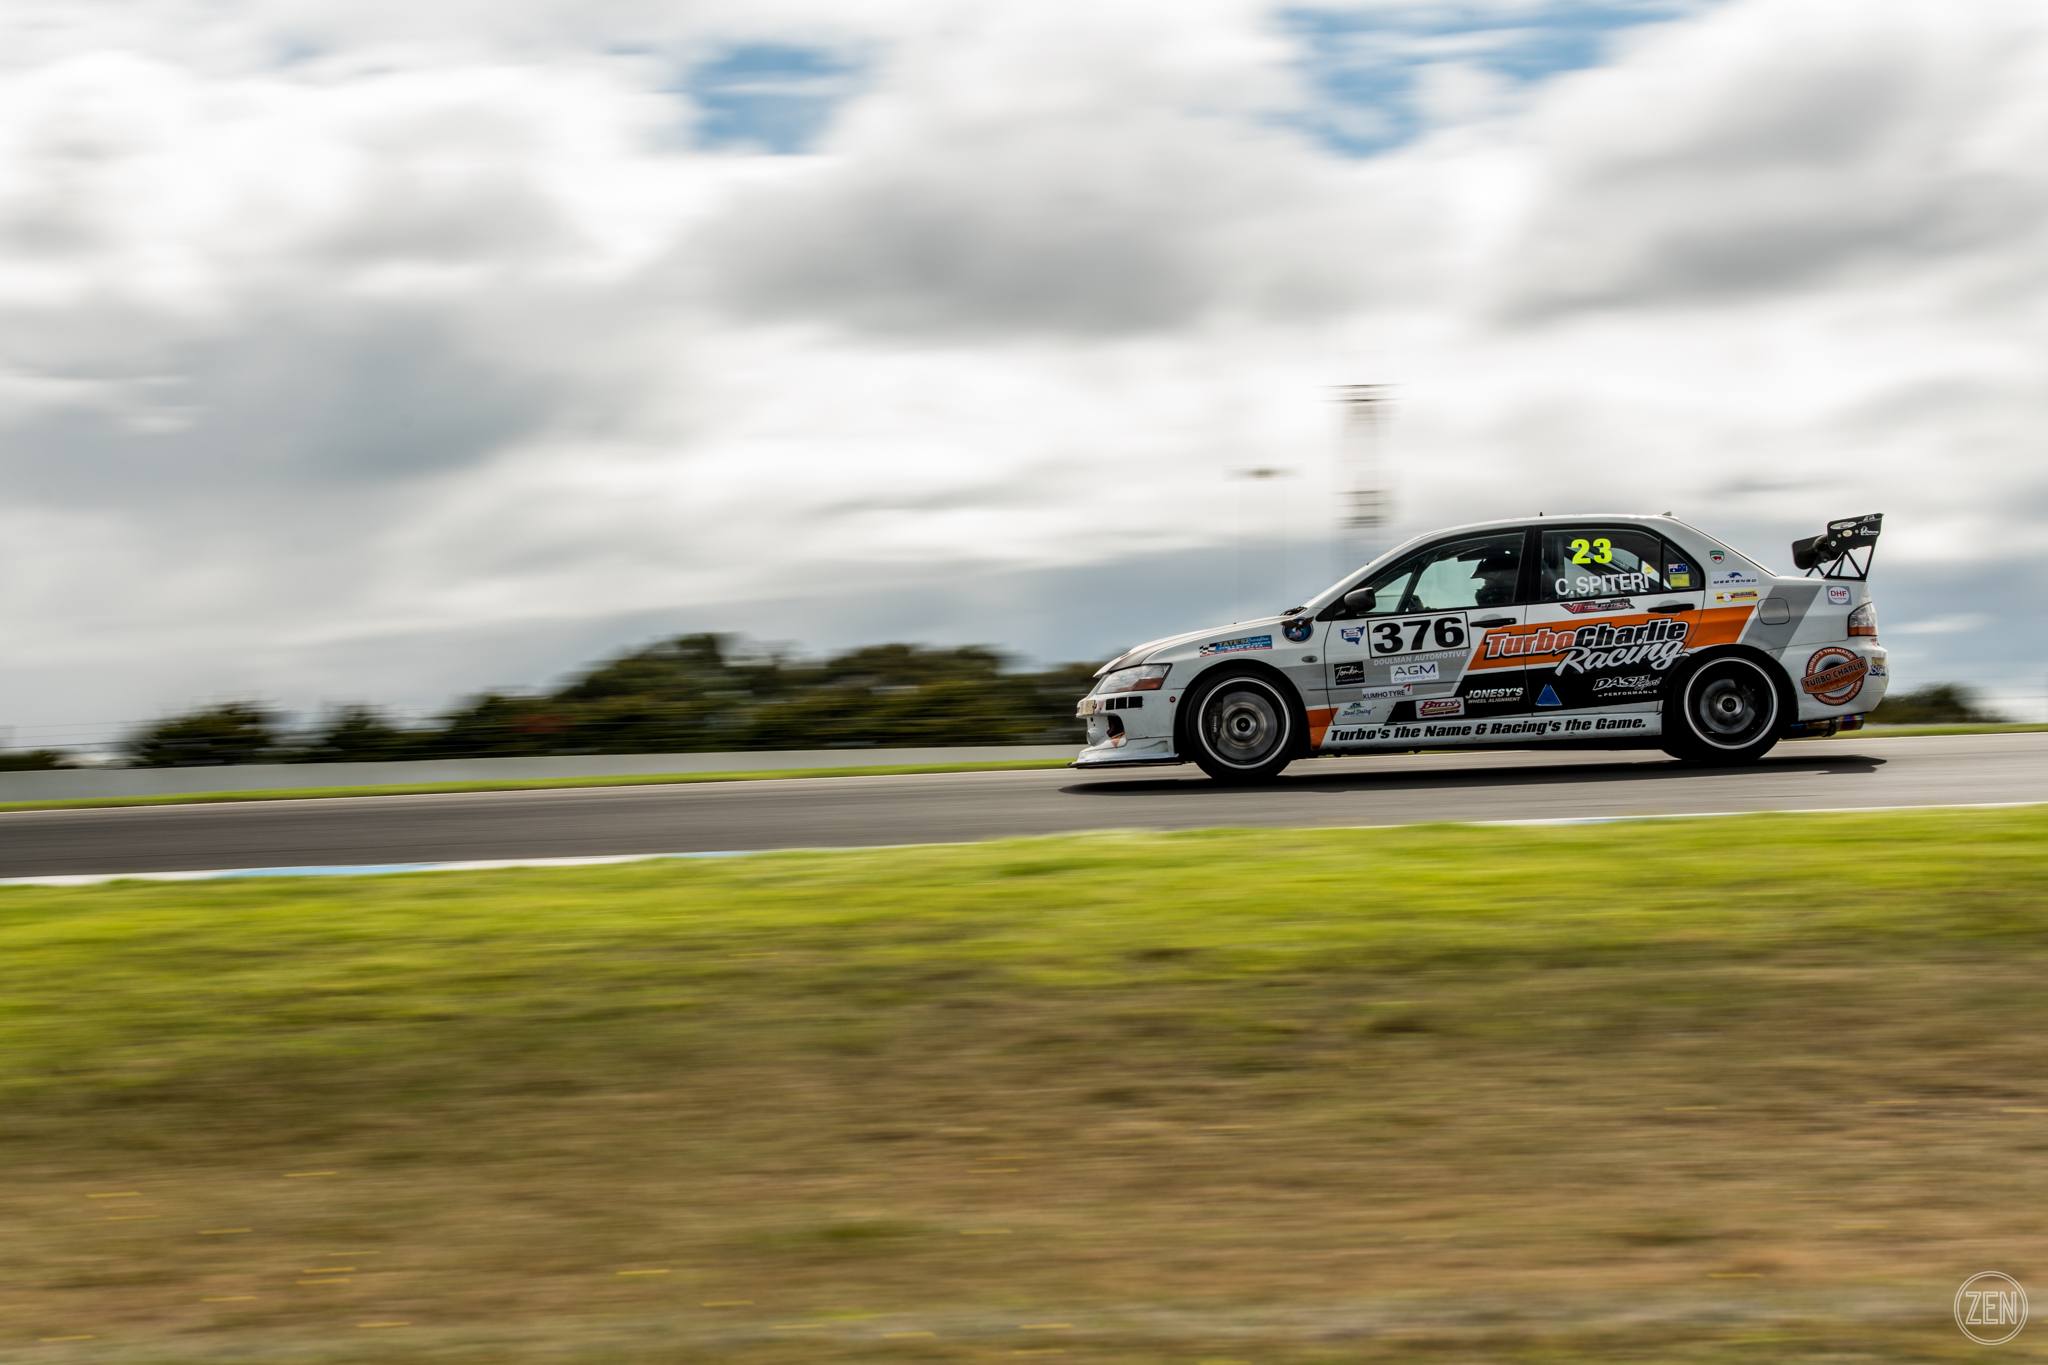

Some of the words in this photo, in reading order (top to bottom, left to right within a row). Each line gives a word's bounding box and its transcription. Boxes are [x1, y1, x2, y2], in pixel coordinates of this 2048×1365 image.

[1570, 538, 1613, 564] 23
[1576, 572, 1650, 594] SPITERI
[1373, 617, 1465, 653] 376
[1373, 656, 1412, 666] DOULMAN
[1414, 650, 1467, 663] AUTOMOTIVE
[1554, 638, 1690, 676] Racing
[1836, 648, 1854, 659] NAME
[1394, 663, 1436, 676] AGM
[1804, 673, 1832, 688] TURBO
[1832, 660, 1865, 678] CHARLIE
[1362, 691, 1388, 700] KUMHO
[1388, 689, 1406, 697] TYRE
[1465, 687, 1524, 699] JONESY'S
[1331, 727, 1391, 741] Turbo's
[1394, 725, 1421, 738] the
[1424, 723, 1472, 737] Name
[1475, 723, 1488, 735] &
[1490, 719, 1562, 736] Racing's
[1564, 718, 1592, 731] the
[1595, 717, 1647, 730] Game.
